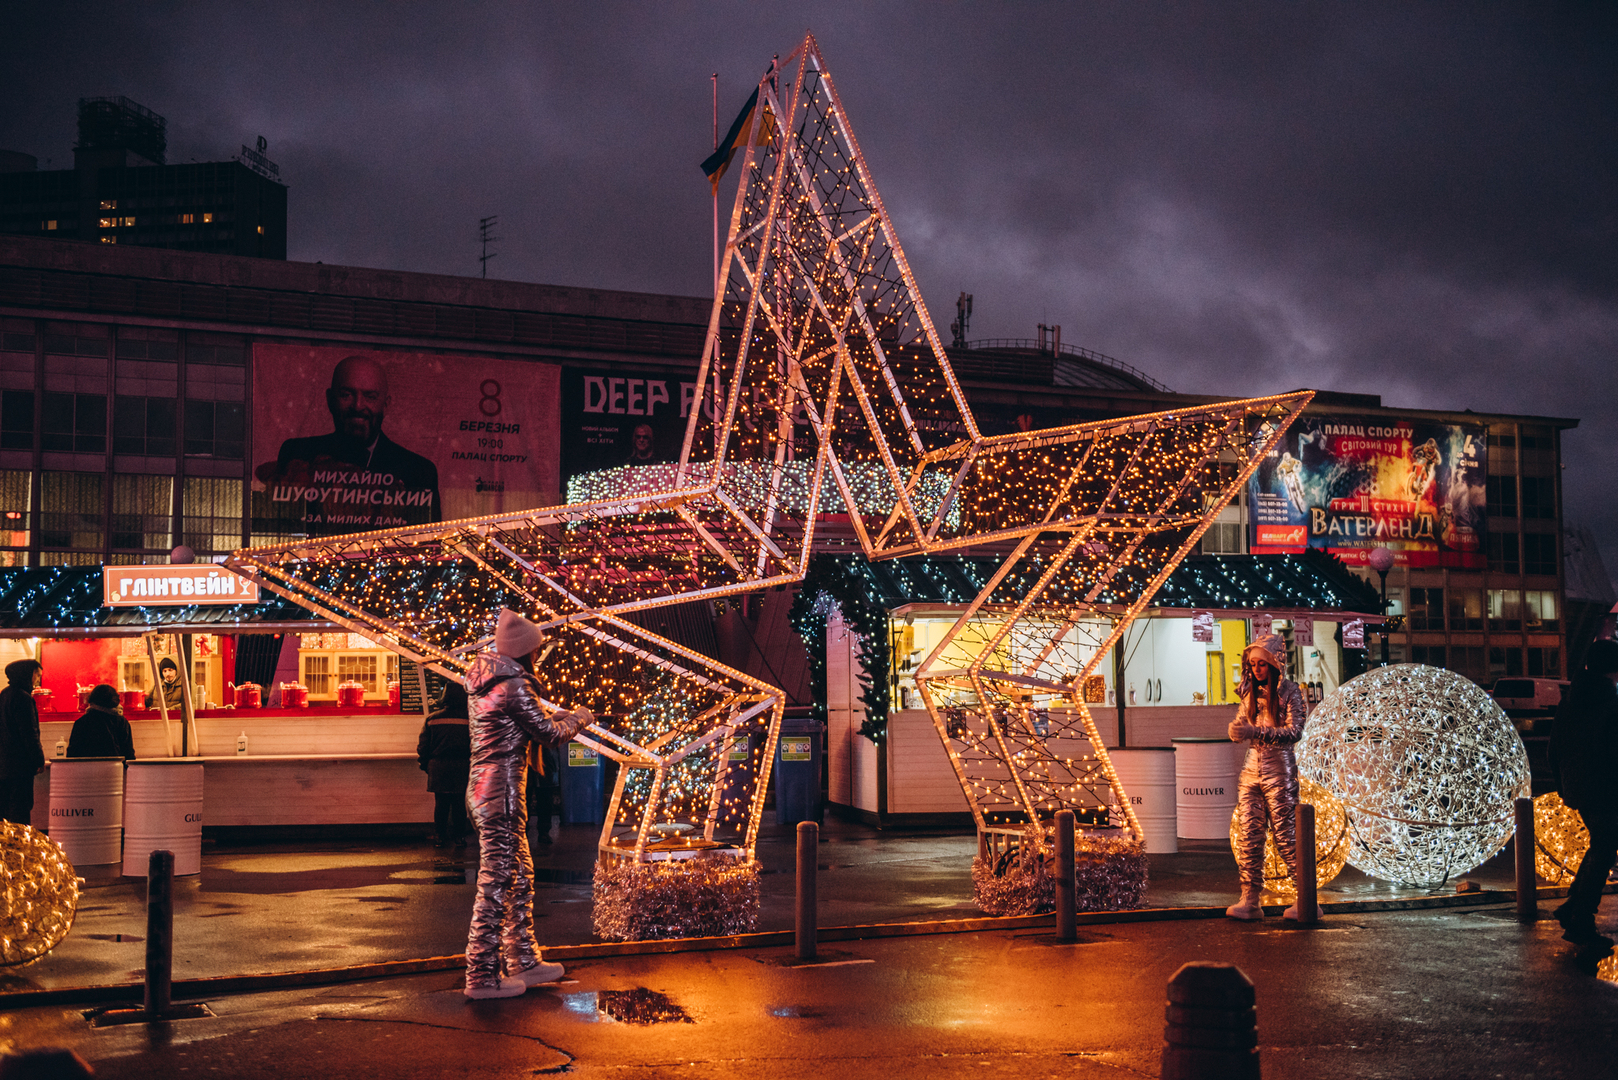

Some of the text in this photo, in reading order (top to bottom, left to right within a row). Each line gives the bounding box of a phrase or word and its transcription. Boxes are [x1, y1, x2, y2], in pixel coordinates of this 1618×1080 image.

[478, 378, 502, 417] 8
[582, 375, 670, 416] DEEP
[459, 420, 520, 434] БЕРЕЗНЯ
[1324, 424, 1414, 438] ПАЛАЦ СПОРТУ
[477, 438, 504, 449] 19:00
[1341, 440, 1398, 454] СВІТОВИЙ ТУР
[1464, 434, 1476, 458] 4
[452, 452, 528, 463] ПАЛАЦ СПОРТУ
[313, 470, 394, 486] МИХАЙЛО
[272, 486, 433, 507] ШУФУТИНСЬКИЙ
[1334, 501, 1355, 510] ТРИ
[1373, 502, 1411, 512] СТИХІЇ
[326, 514, 371, 525] МИЛИХ
[120, 572, 235, 596] ГЛІНТВЕЙН
[1183, 787, 1224, 796] GULLIVER
[51, 808, 94, 817] GULLIVER
